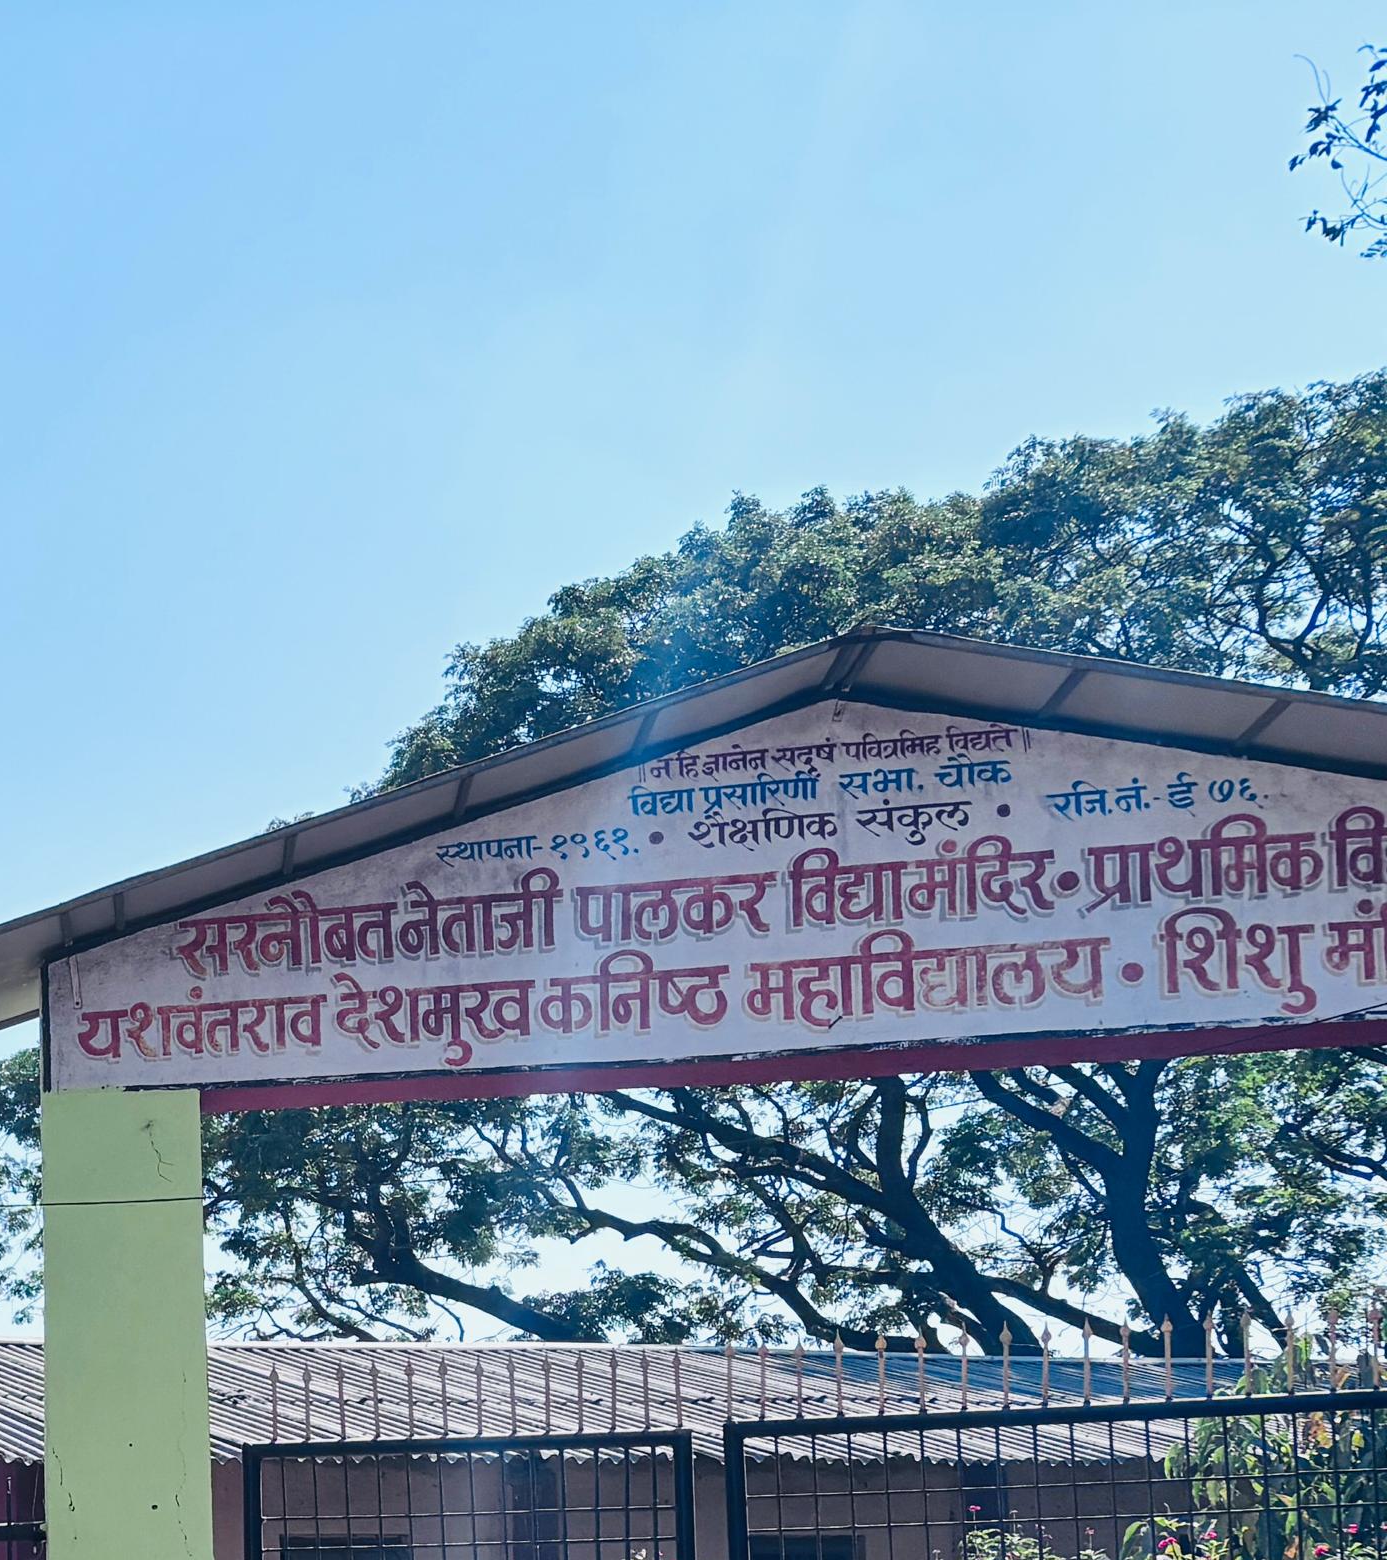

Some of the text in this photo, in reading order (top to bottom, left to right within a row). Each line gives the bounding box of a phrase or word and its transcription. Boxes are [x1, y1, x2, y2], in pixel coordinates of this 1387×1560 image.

[841, 729, 941, 759] पवित्रमिह
[945, 722, 1018, 754] विद्यते
[628, 786, 696, 817] विद्या
[935, 752, 1012, 789] चौक
[688, 796, 973, 851] शैक्षणिक संकुल
[398, 867, 564, 957] नेताजी
[576, 870, 779, 943] पालकर
[1084, 813, 1324, 914] प्राथमिक
[77, 985, 327, 1061] यशवंतराव
[334, 972, 536, 1067] देशमुख
[539, 949, 731, 1034] कनिष्ठ
[747, 928, 1111, 1029] महाविद्यालय
[1159, 906, 1318, 1015] शिशु
